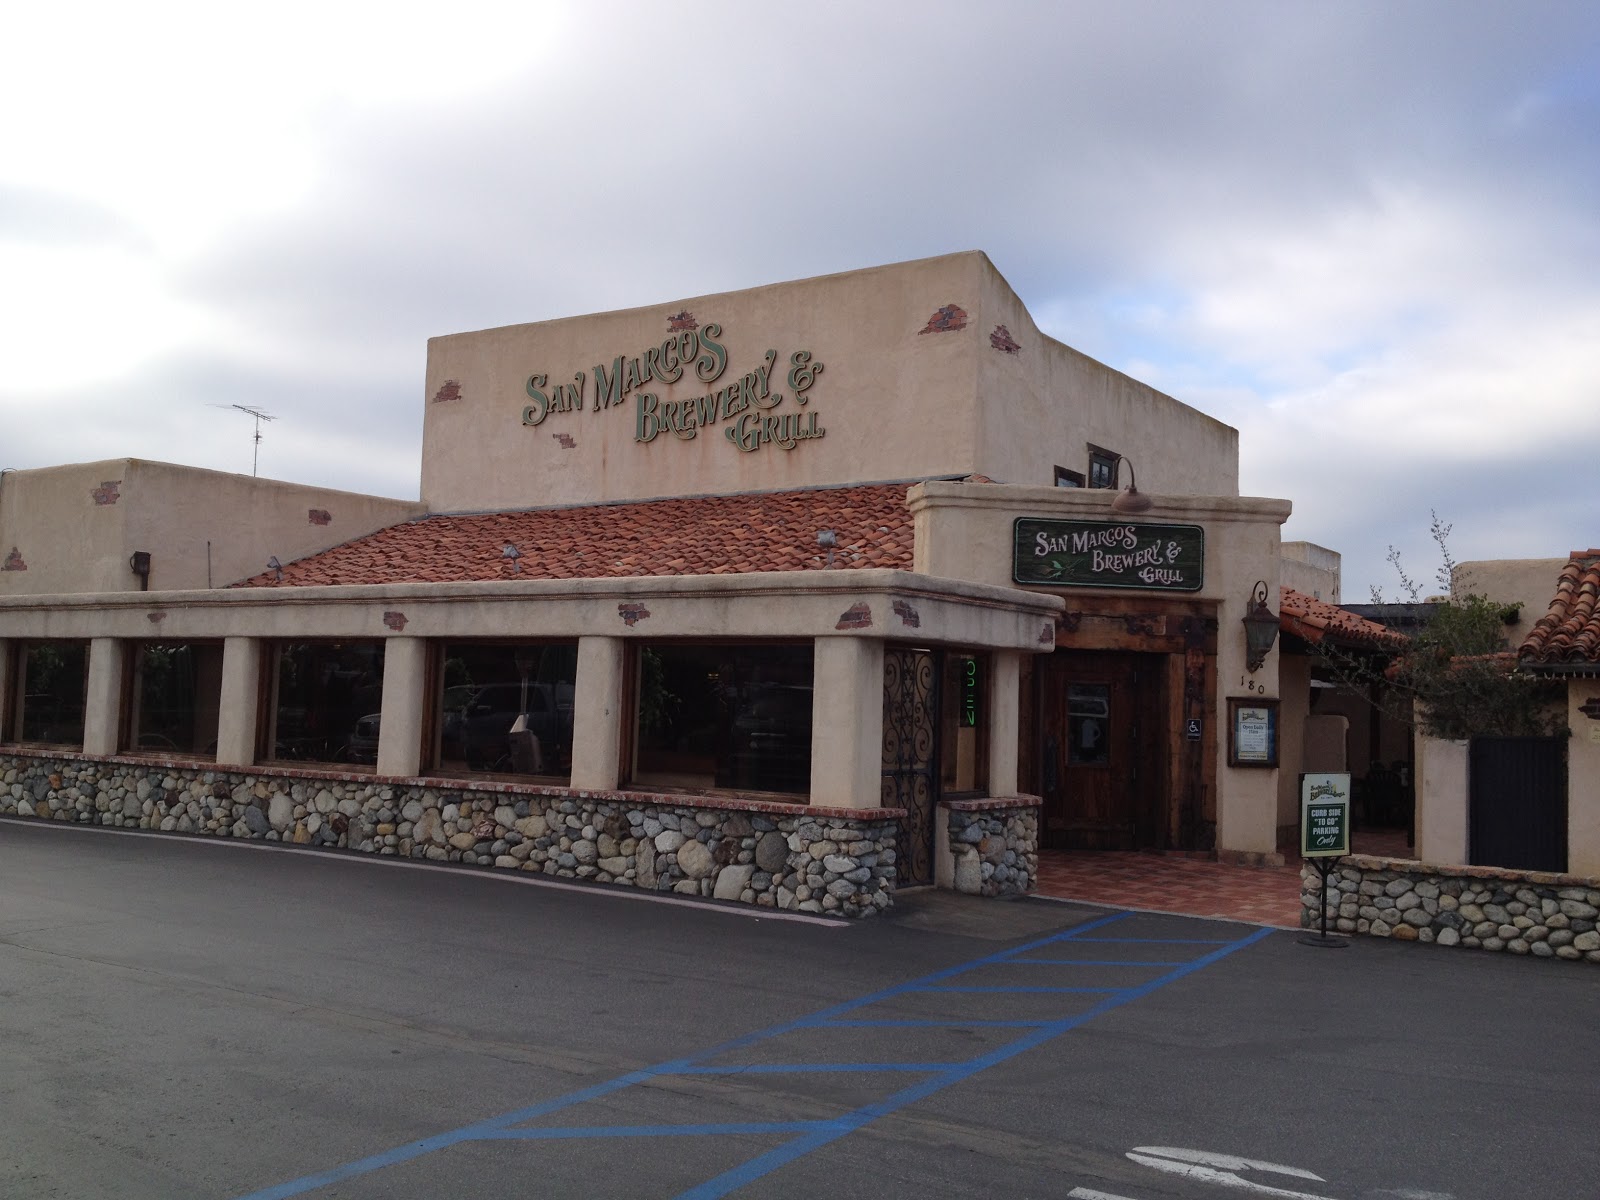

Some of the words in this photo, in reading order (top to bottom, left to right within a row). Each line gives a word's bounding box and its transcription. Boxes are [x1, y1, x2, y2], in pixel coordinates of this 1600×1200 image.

[522, 371, 584, 426] SAN
[591, 322, 727, 411] MARCOS
[635, 349, 782, 442] BREWERY
[787, 350, 824, 405] &
[724, 410, 825, 452] GRILL
[1035, 531, 1068, 556] SAN
[1072, 526, 1138, 554] MARCOS
[1092, 540, 1163, 572] BREWERY
[1166, 541, 1181, 563] &
[1138, 567, 1183, 584] GRILL
[1241, 676, 1264, 694] 180
[1312, 809, 1328, 817] CURB
[1312, 826, 1340, 835] PARKING
[1316, 834, 1336, 846] Only
